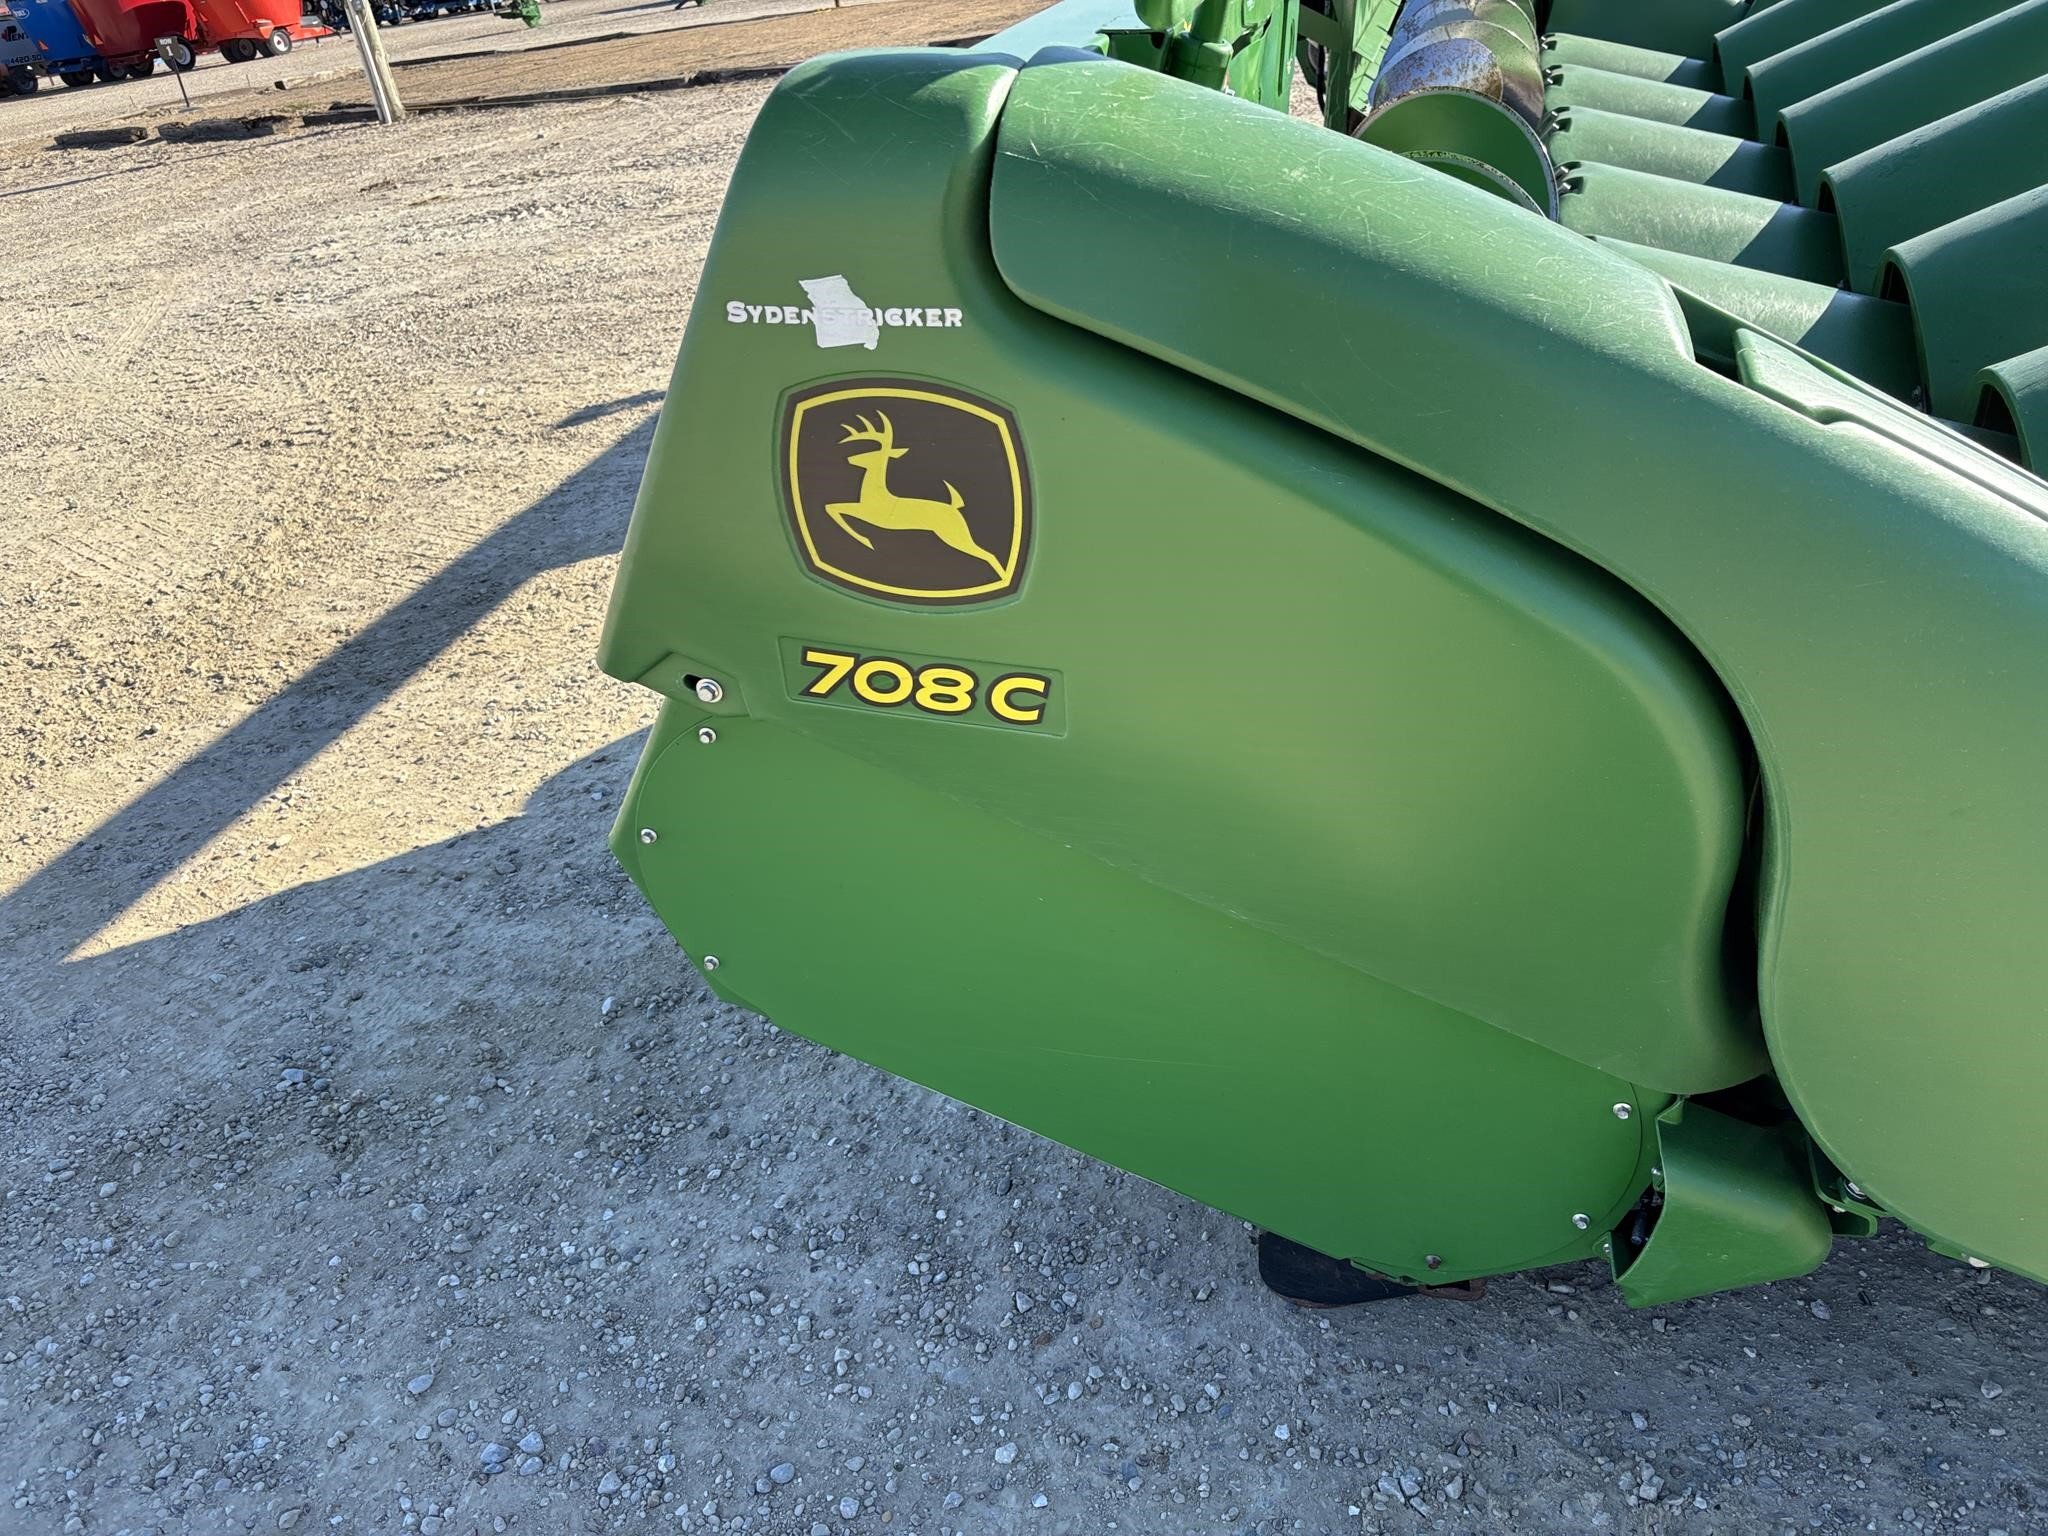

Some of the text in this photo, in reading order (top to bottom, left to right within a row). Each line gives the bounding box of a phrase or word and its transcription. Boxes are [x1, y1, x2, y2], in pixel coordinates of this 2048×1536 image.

[166, 45, 174, 56] 1
[800, 647, 1050, 725] 708 C
